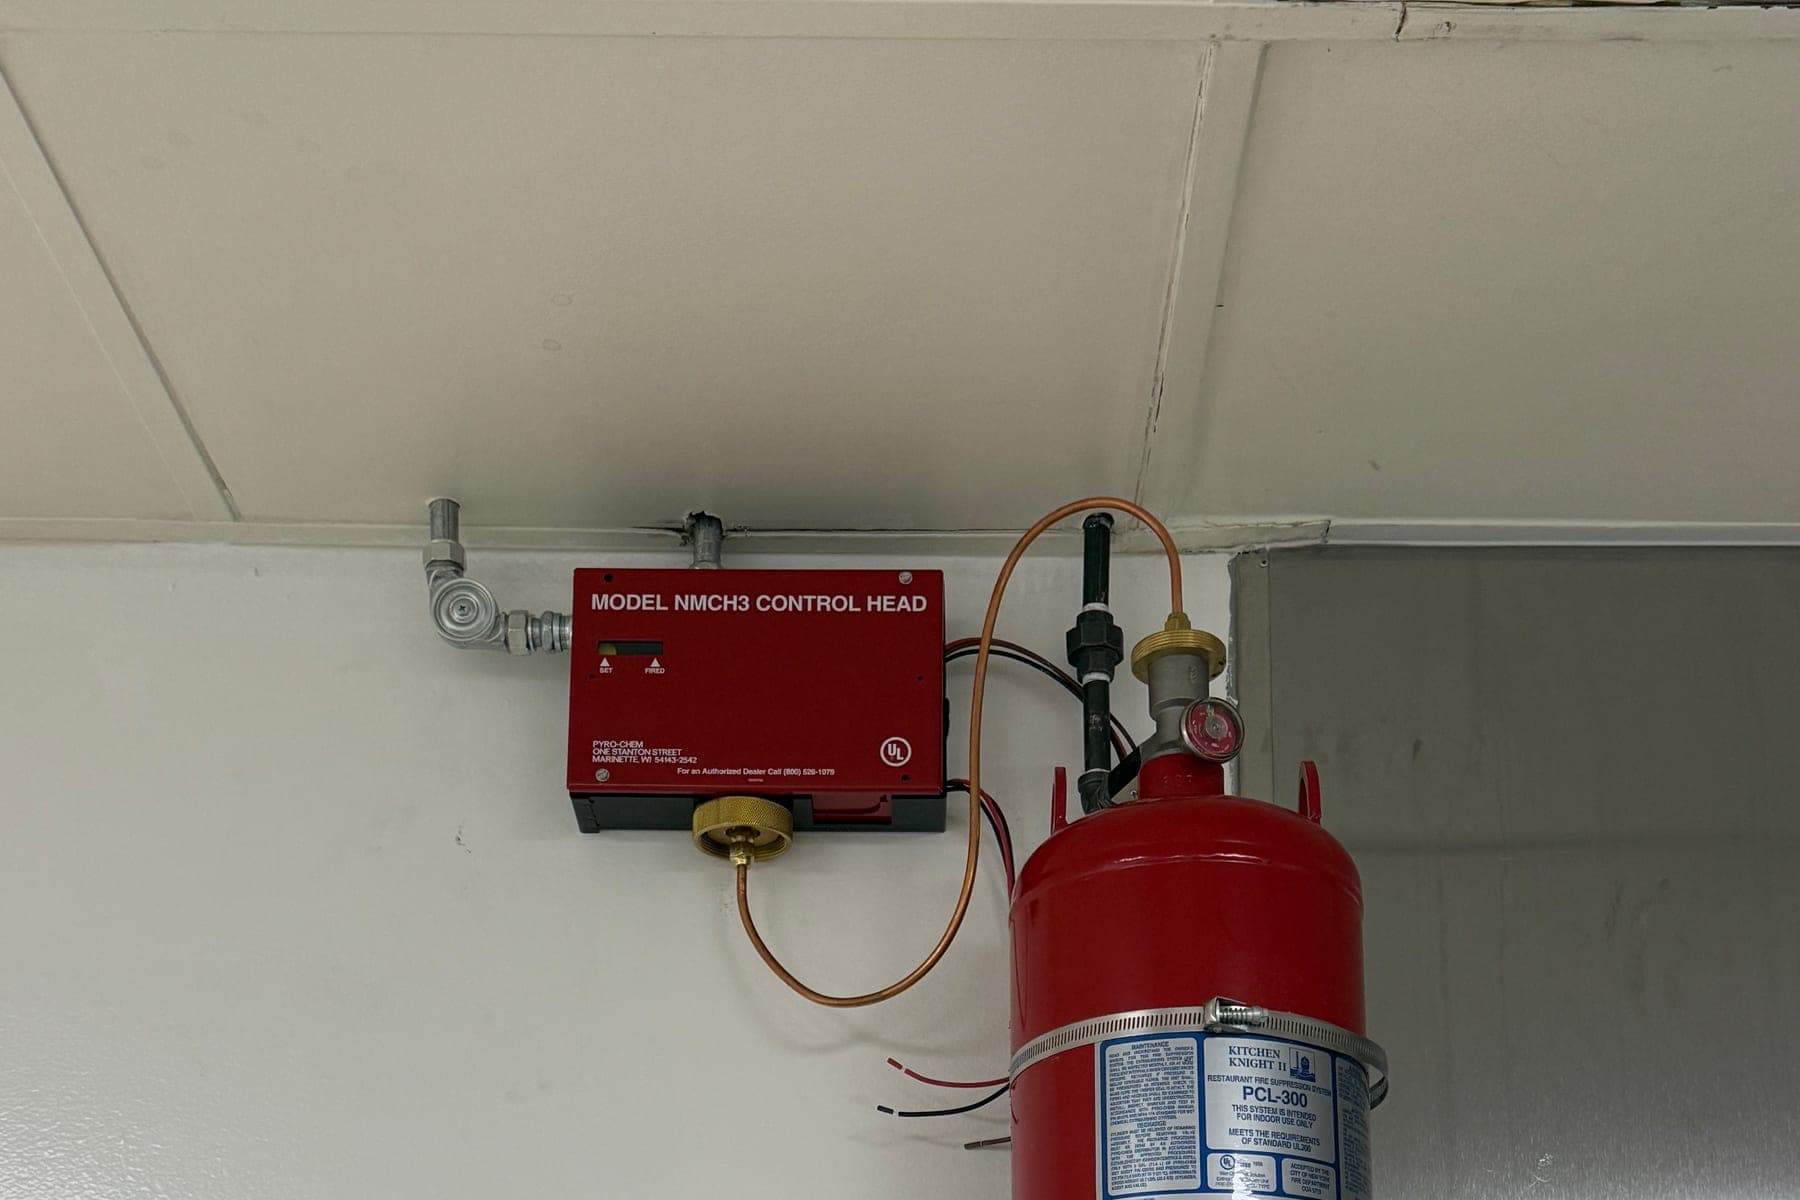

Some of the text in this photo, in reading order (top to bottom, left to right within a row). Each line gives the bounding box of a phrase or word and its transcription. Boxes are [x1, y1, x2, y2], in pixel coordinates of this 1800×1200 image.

[591, 594, 927, 612] MODEL NMCH3 CONTROL HEAD
[592, 740, 644, 748] PYRO-CHEM
[592, 748, 682, 756] ONE STANTON STREET
[676, 767, 689, 775] For
[702, 767, 742, 775] Authorized
[743, 767, 766, 775] Dealer
[767, 767, 782, 775] Call
[1228, 1045, 1280, 1058] KITCHEN
[1229, 1057, 1275, 1069] KNIGHT
[1207, 1074, 1254, 1084] RESTAURANT
[1254, 1076, 1270, 1085] FIRE
[1270, 1078, 1311, 1091] SUPPRESSION
[1242, 1086, 1308, 1108] PCL-300
[1232, 1104, 1316, 1121] THIS SYSTEM IS INTENDED
[1236, 1113, 1313, 1129] FOR INDOOR USE ONLY
[1228, 1128, 1321, 1146] MEETS THE REQUIREMENTS
[1241, 1137, 1312, 1153] OF STANDARD UL300
